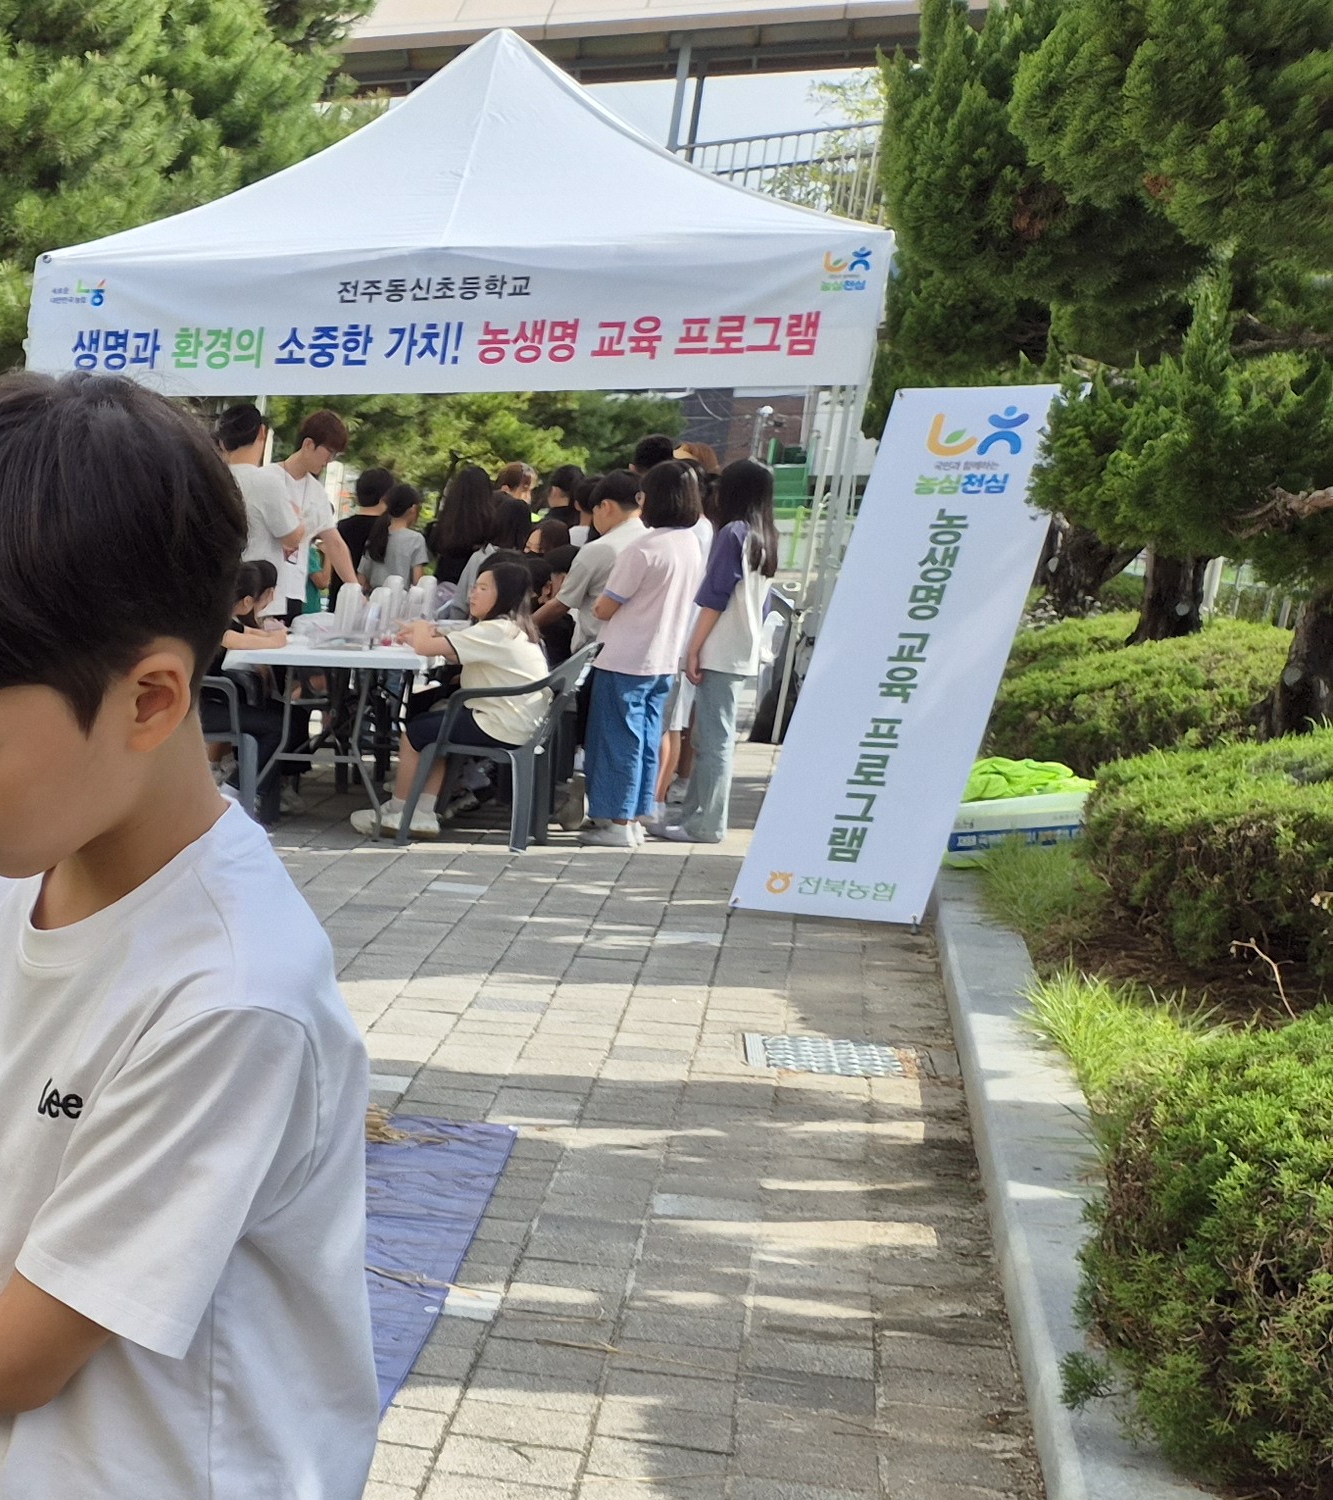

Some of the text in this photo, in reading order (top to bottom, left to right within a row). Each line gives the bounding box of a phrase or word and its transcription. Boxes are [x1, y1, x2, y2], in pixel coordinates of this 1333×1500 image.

[337, 274, 531, 303] 전주동신초등학교
[71, 310, 821, 372] 생명과 환경의 소중한 가치! 농생명 교육 프로그램
[914, 473, 1010, 496] 농심천심
[827, 508, 969, 863] 농생명 교육 프로그램
[797, 875, 897, 902] 전북농협
[37, 1077, 84, 1119] Lee
